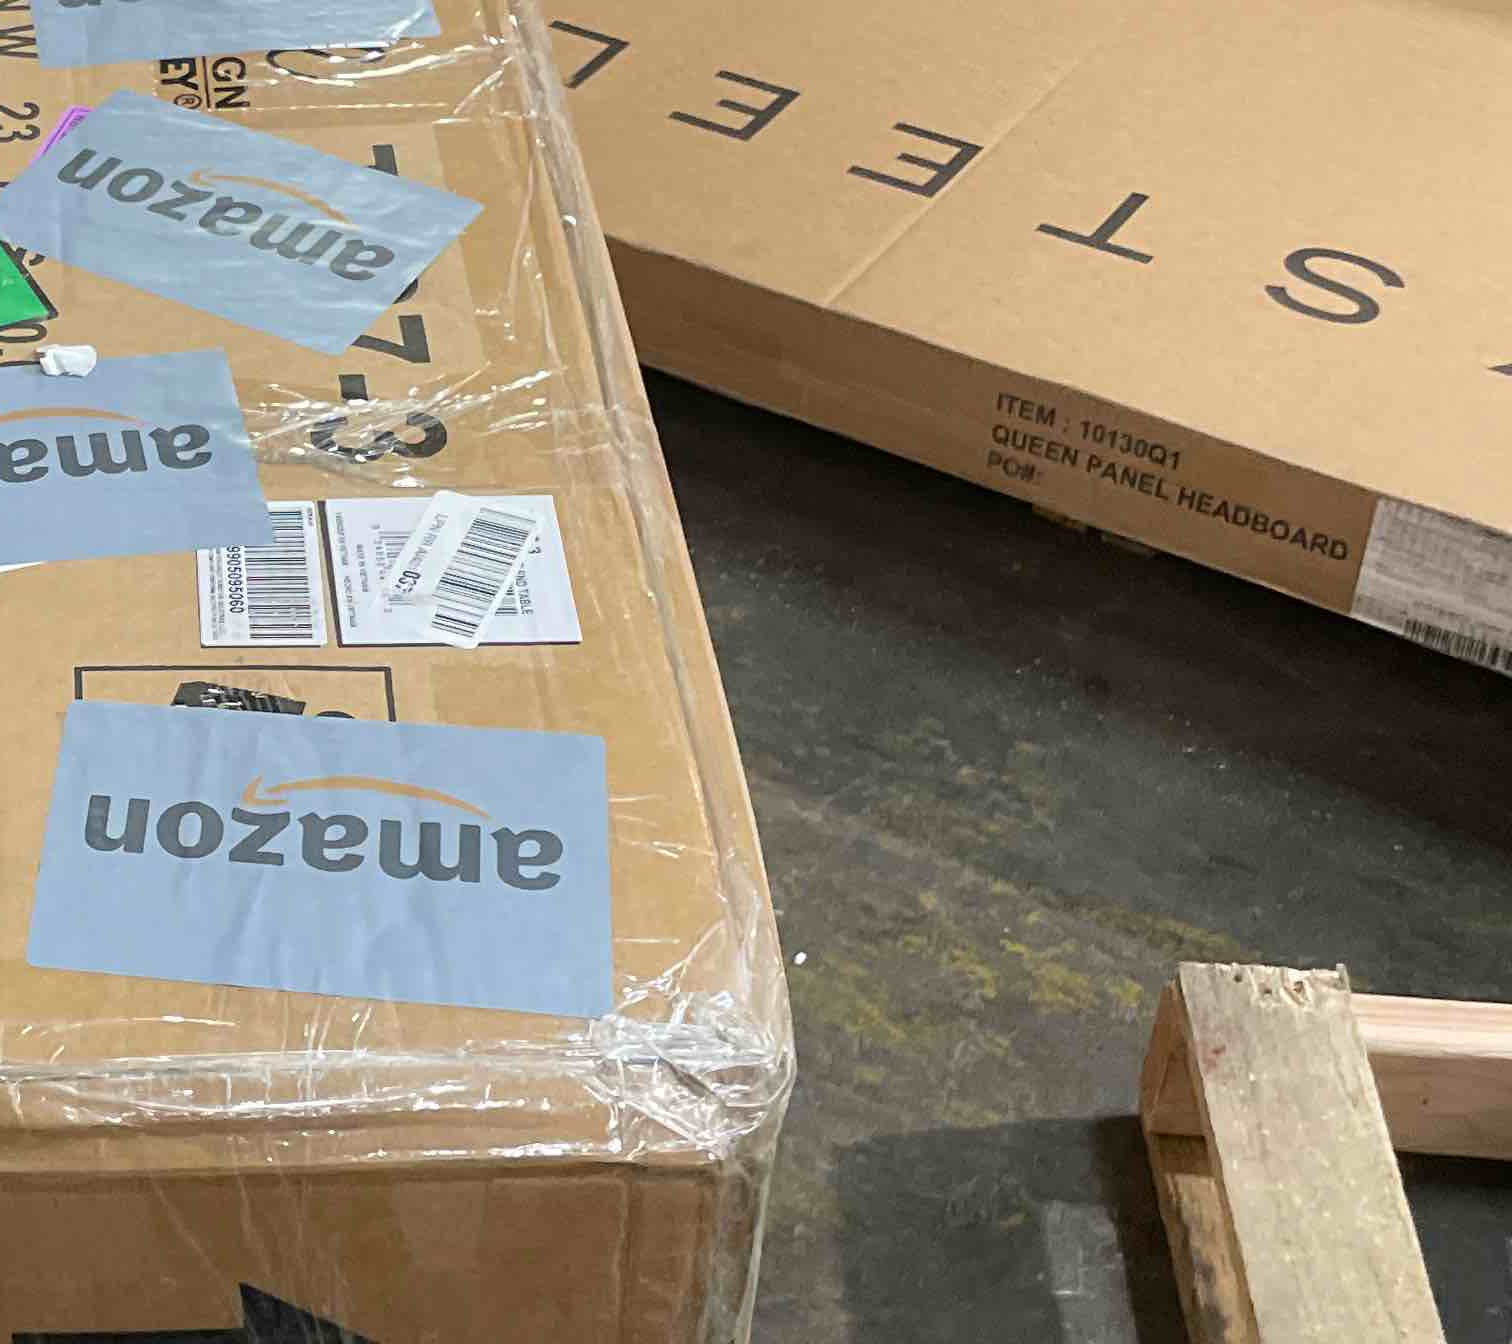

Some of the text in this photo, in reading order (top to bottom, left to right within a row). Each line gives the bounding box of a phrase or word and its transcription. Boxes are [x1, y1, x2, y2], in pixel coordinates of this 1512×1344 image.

[56, 146, 399, 284] amazon
[996, 392, 1056, 428] ITEM
[990, 424, 1350, 562] QUEEN PANEL HEADBOARD
[82, 794, 567, 895] amazon
